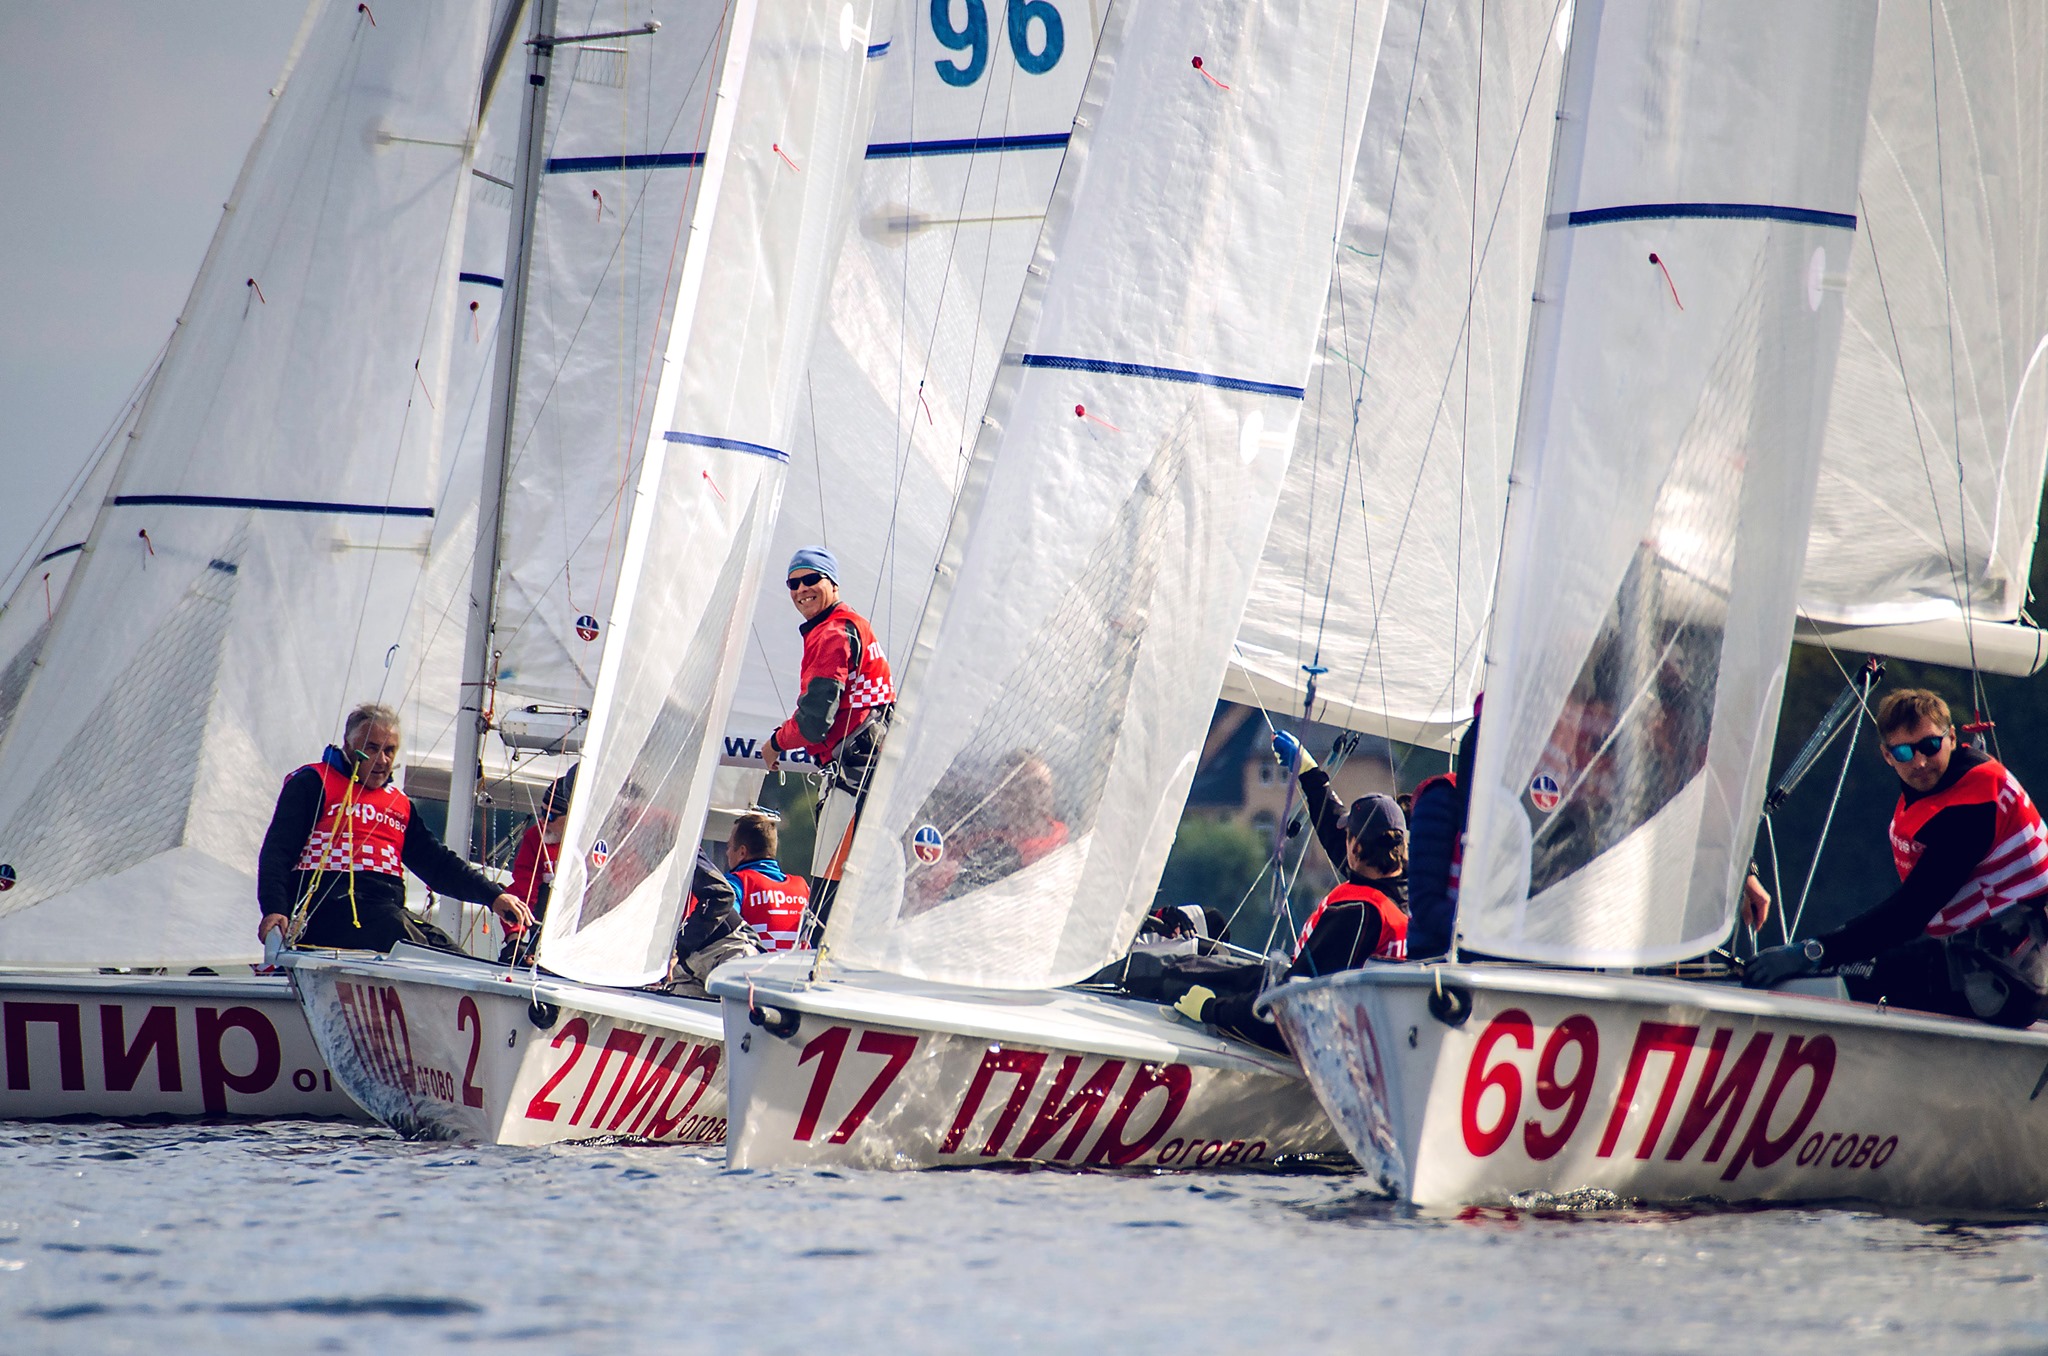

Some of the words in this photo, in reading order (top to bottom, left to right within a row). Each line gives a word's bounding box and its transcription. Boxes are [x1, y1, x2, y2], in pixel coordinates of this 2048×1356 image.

[931, 0, 1065, 87] 96
[457, 995, 484, 1109] 2
[525, 1017, 590, 1122] 2
[793, 1025, 919, 1145] 17
[1460, 1008, 1599, 1161] 69
